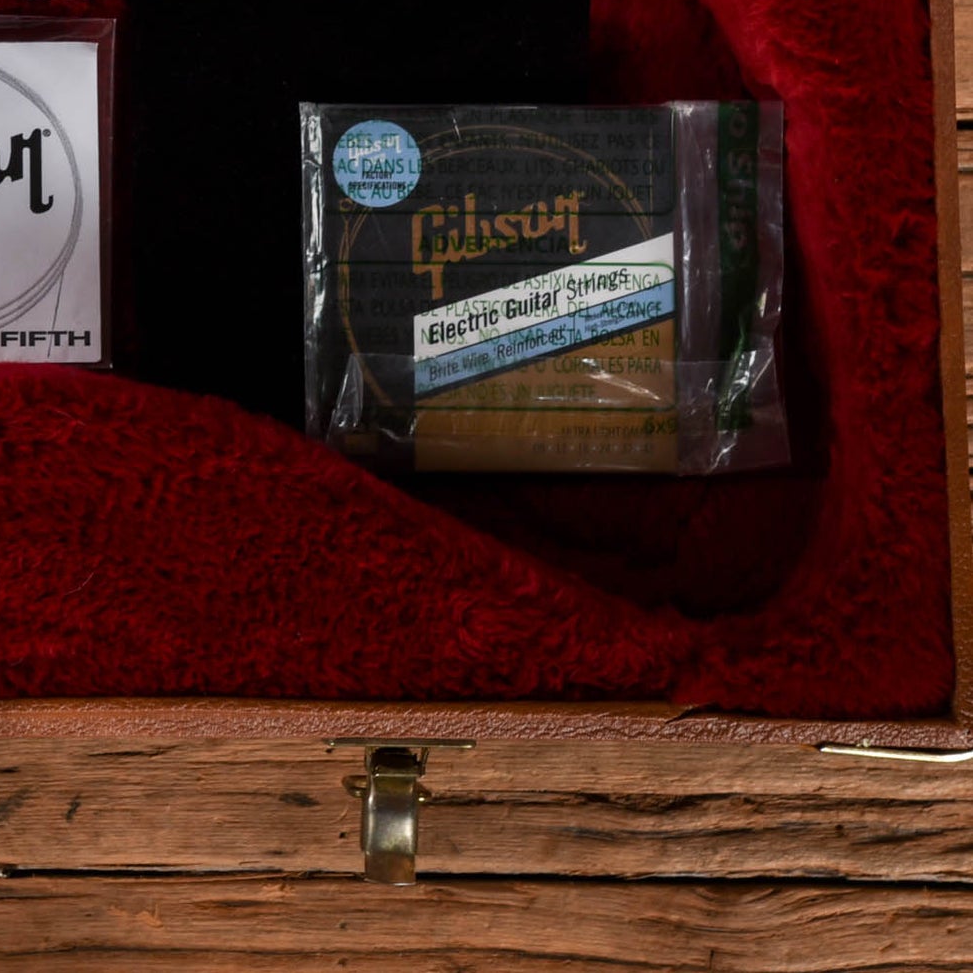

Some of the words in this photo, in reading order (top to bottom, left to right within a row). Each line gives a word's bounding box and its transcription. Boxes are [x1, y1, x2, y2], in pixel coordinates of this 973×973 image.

[362, 158, 404, 174] DANS
[411, 189, 589, 301] Gibson
[429, 306, 499, 345] Electric
[505, 288, 562, 320] Guitar
[566, 267, 629, 301] Strings
[567, 301, 591, 318] DEL
[0, 331, 92, 347] FIFTH
[642, 329, 660, 346] EN
[429, 361, 460, 382] Brite
[462, 352, 490, 371] Wire
[628, 357, 662, 375] PARA
